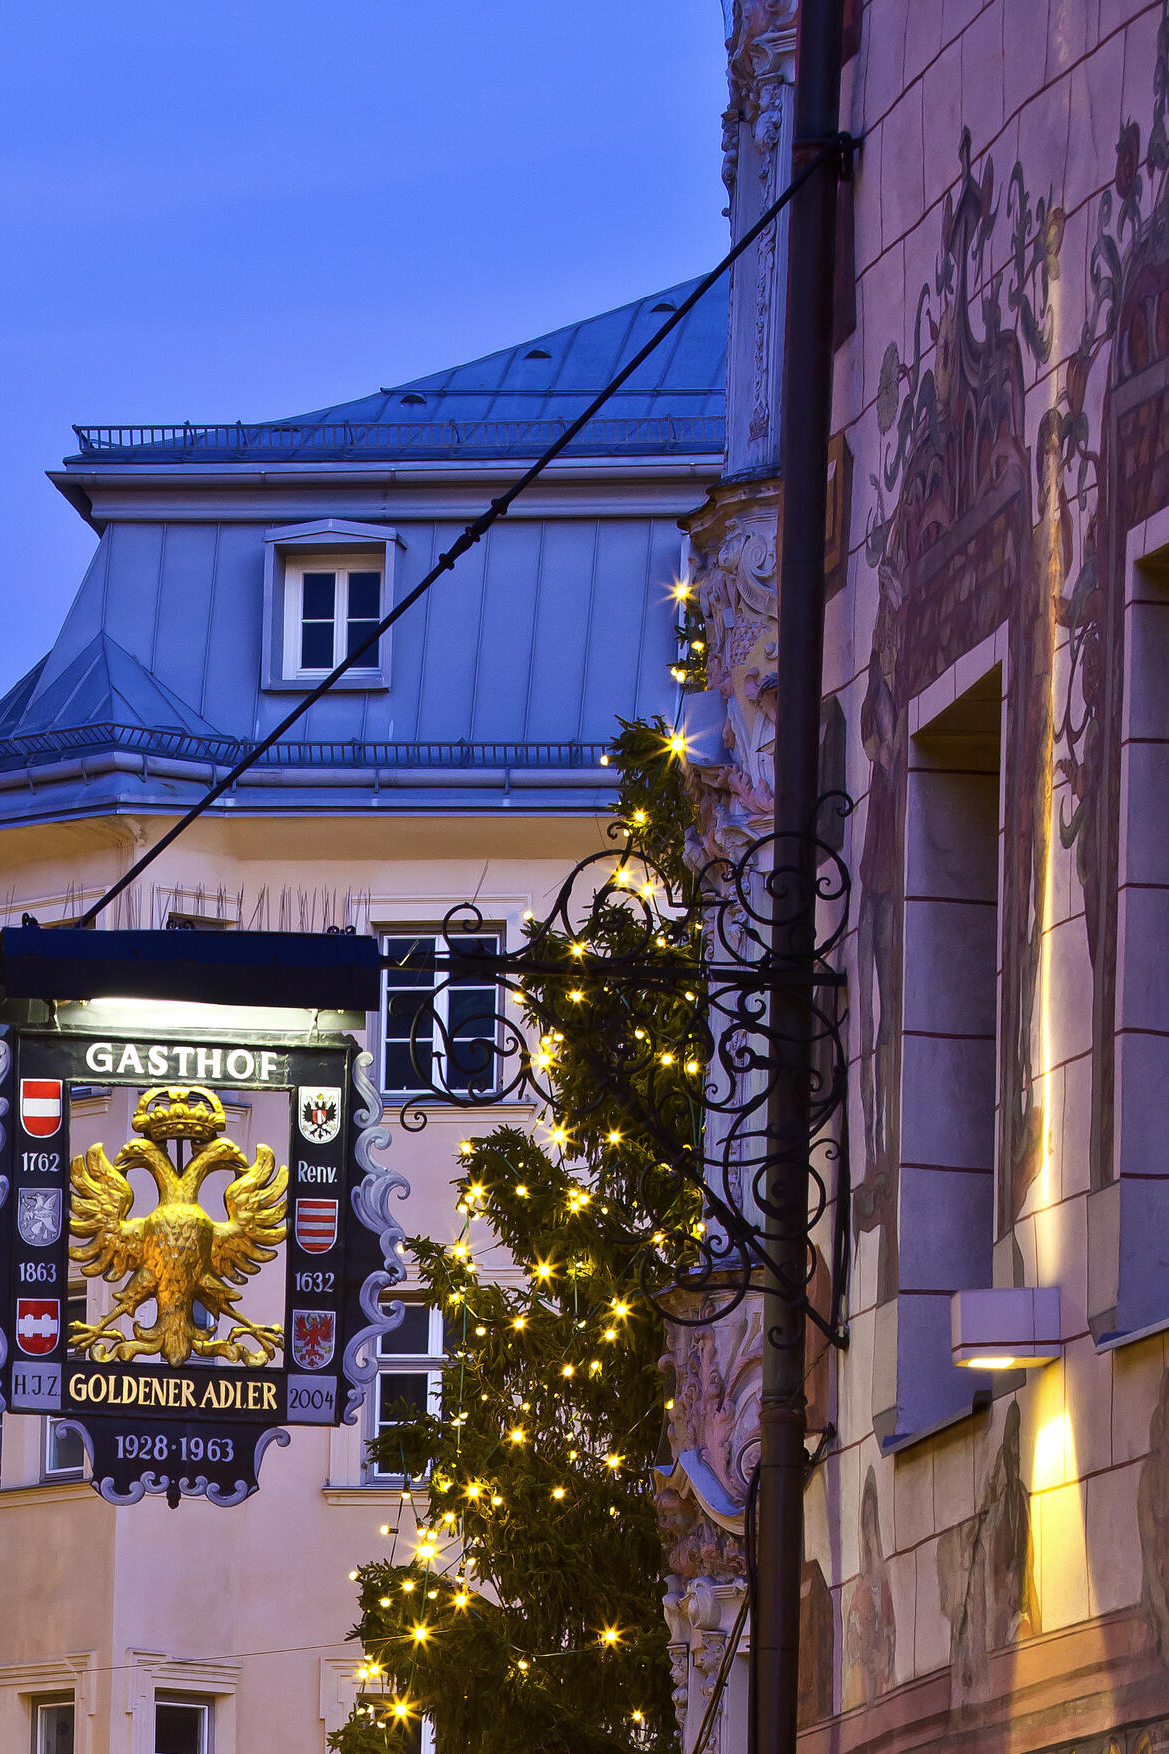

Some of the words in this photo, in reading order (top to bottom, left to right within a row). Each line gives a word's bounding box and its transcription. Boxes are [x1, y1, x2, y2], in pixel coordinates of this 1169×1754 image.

[85, 1042, 278, 1081] GASTHOF
[21, 1152, 61, 1172] 1762
[298, 1160, 338, 1183] Renv.
[18, 1262, 57, 1283] 1863
[295, 1271, 335, 1293] 1632
[68, 1373, 197, 1407] GOLDENER
[199, 1380, 278, 1410] ADLER
[289, 1388, 334, 1410] 2004
